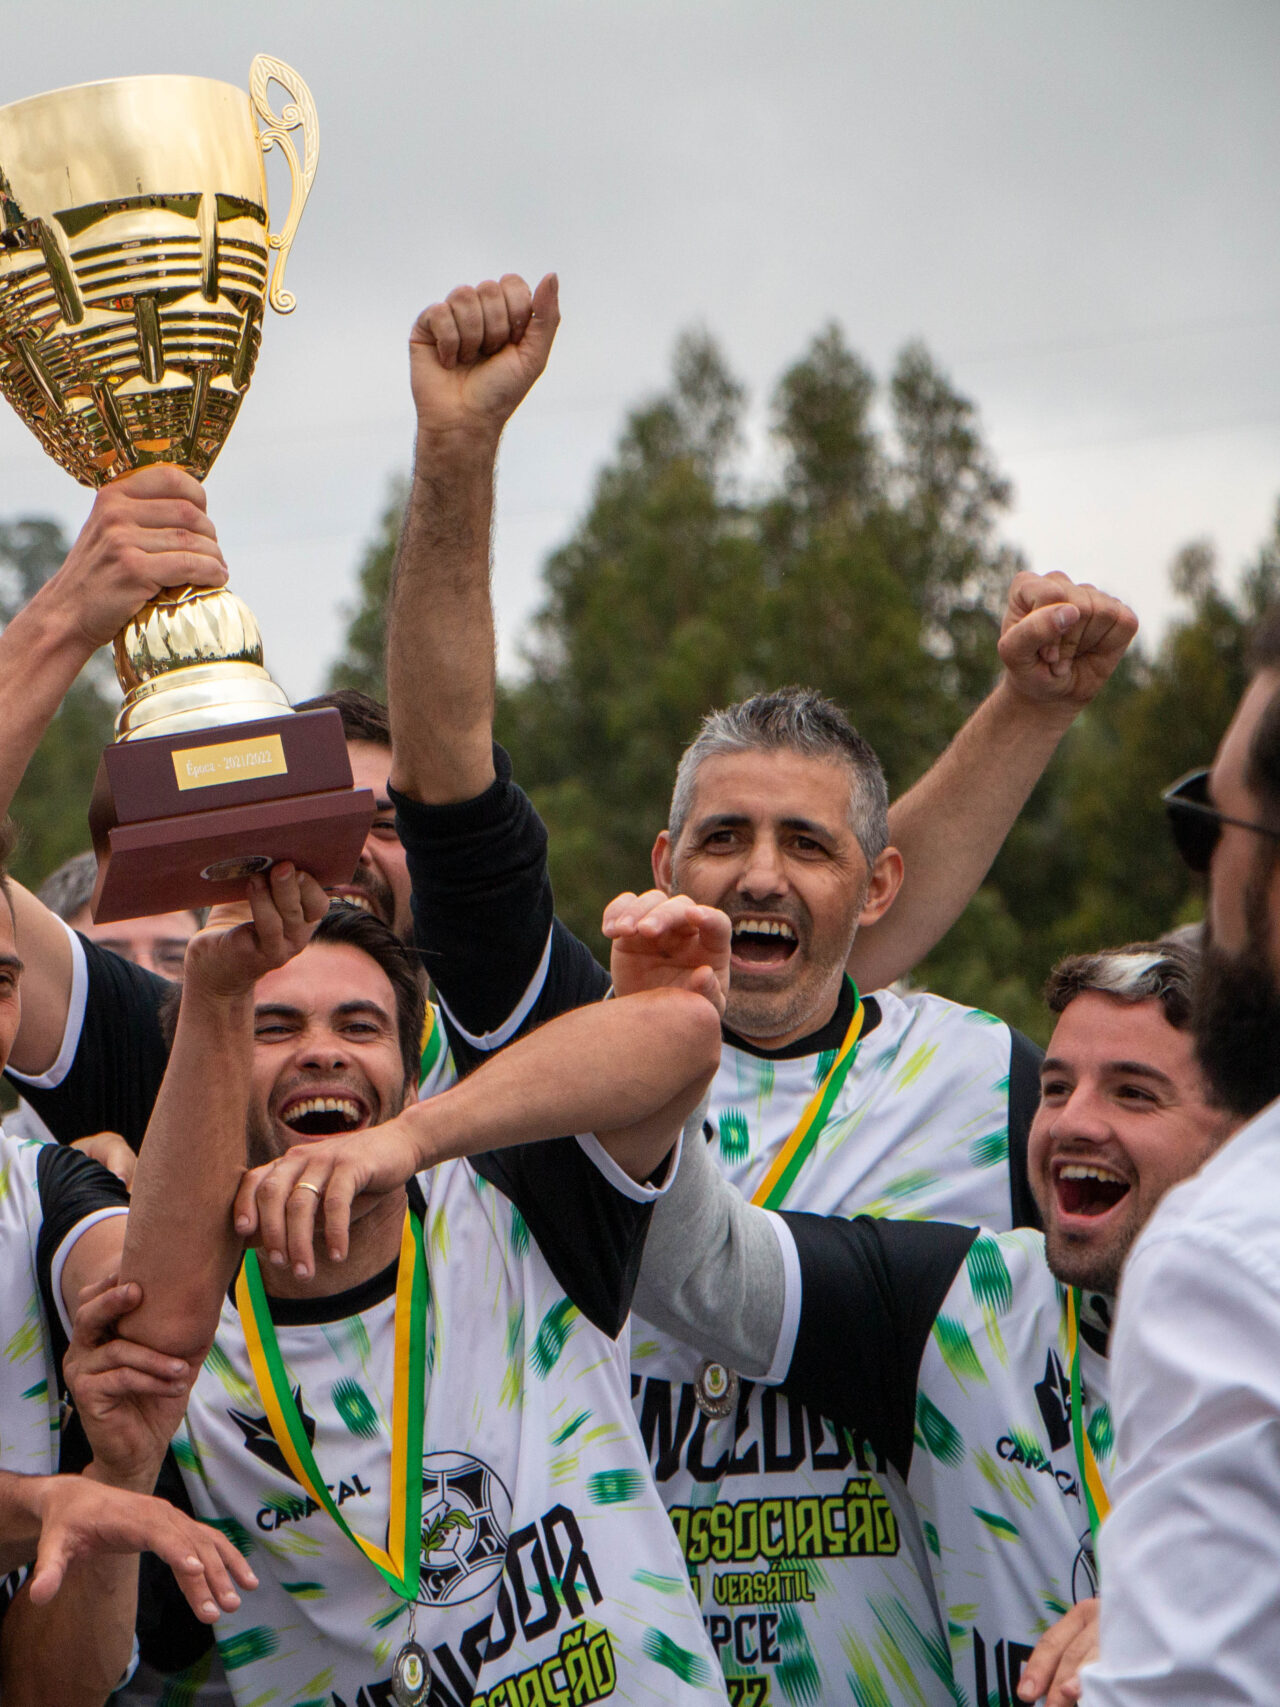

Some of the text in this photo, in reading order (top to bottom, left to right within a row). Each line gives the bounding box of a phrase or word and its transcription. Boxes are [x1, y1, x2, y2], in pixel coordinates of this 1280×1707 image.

[185, 759, 216, 779] Época
[255, 1473, 371, 1532] CARAAL
[712, 1561, 817, 1606] VERSÁTIL
[702, 1612, 782, 1666] PCE
